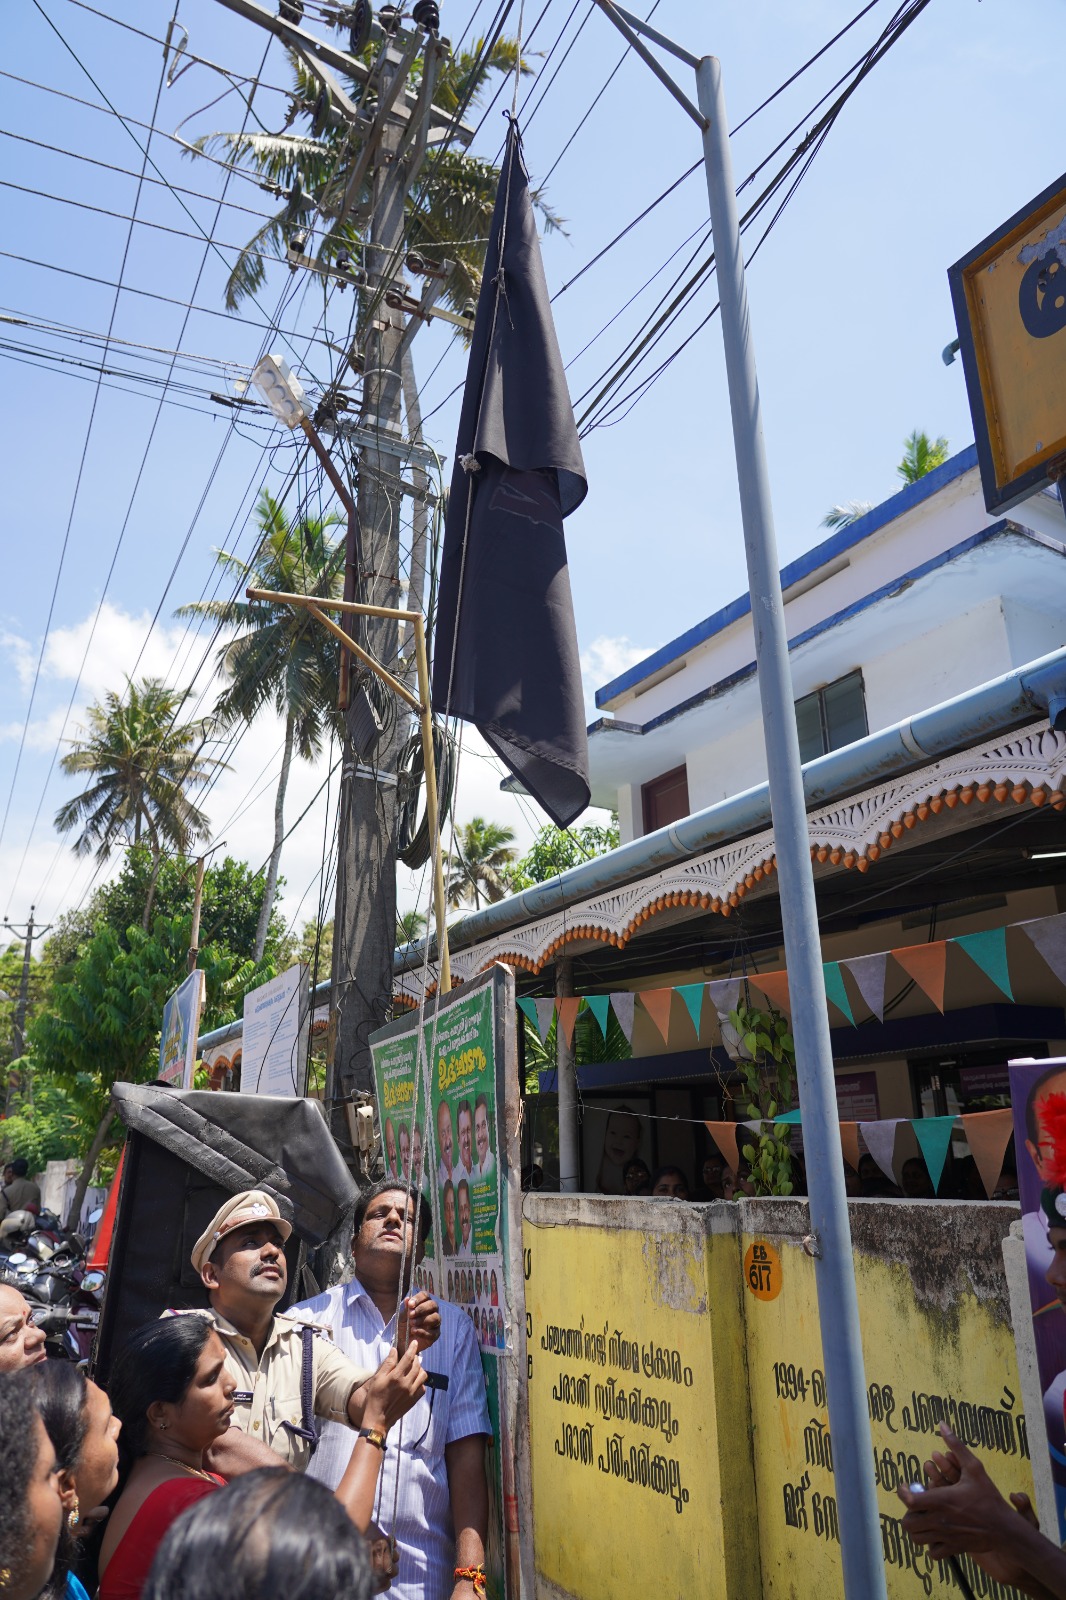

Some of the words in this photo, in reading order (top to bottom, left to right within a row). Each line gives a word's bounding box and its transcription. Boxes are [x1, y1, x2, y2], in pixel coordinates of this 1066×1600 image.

[749, 1264, 772, 1292] 617
[753, 1244, 768, 1260] EB
[584, 1320, 608, 1366] രാജ്
[608, 1329, 640, 1374] നിയമ
[641, 1340, 694, 1387] പ്രകാരം
[552, 1372, 592, 1413] പരാതി
[594, 1377, 680, 1444] സ്വീകരിക്കലും
[554, 1421, 595, 1467] പരാതി
[597, 1432, 690, 1515] പരിഹരിക്കലും
